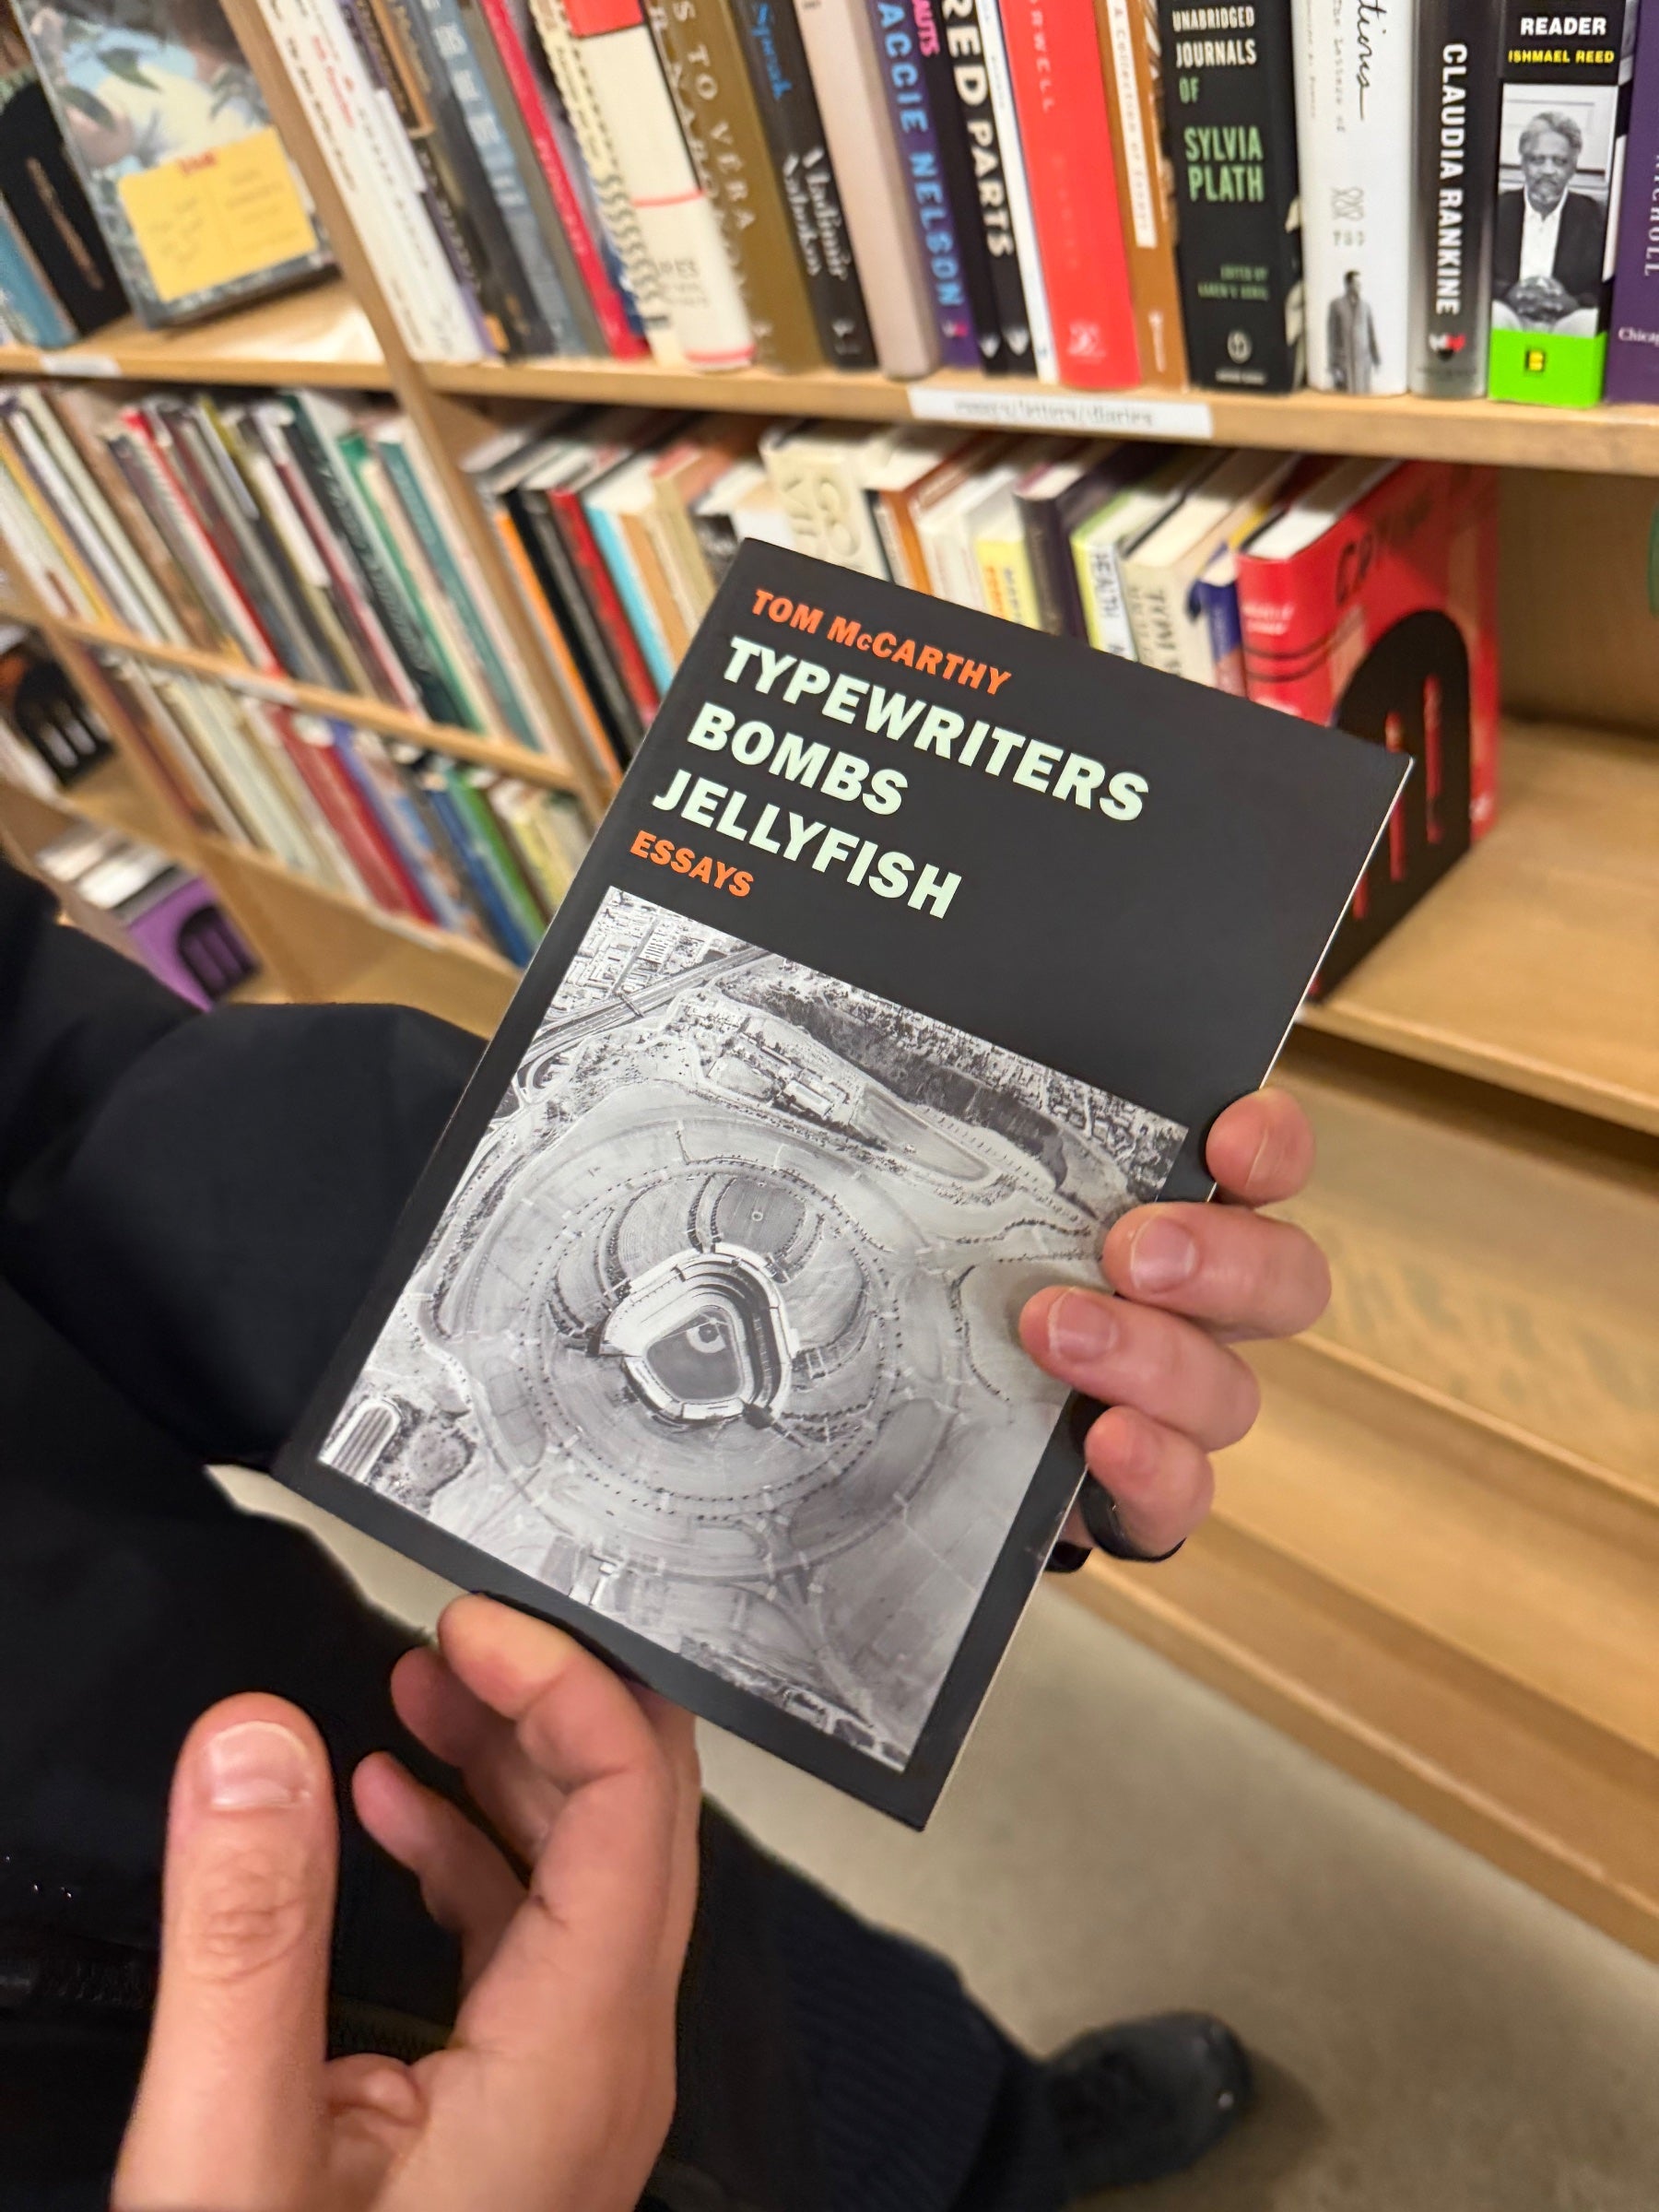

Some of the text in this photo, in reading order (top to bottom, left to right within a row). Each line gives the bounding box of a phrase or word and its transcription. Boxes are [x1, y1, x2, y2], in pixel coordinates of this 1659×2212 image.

[1029, 0, 1055, 112] RWELL
[1172, 6, 1255, 32] UNABRIDGED
[1175, 39, 1257, 69] JOURNALS
[1507, 50, 1616, 65] ISHMAEL REED
[1520, 17, 1607, 36] READER
[688, 42, 719, 101] TO
[1179, 76, 1199, 104] OF
[942, 0, 988, 106] RED
[967, 120, 1014, 258] PARTS
[1184, 126, 1264, 161] SYLVIA
[803, 147, 852, 281] Vladimir
[1187, 164, 1265, 202] PLATH
[1436, 42, 1467, 315] CLAUDIA RANKINE
[910, 151, 965, 305] NELSON
[751, 588, 1012, 696] TOM McCARTHY
[687, 701, 909, 817] BOMBS
[723, 636, 1149, 822] TYPEWRITERS
[629, 830, 754, 898] ESSAYS
[652, 769, 962, 920] JELLYFISH
